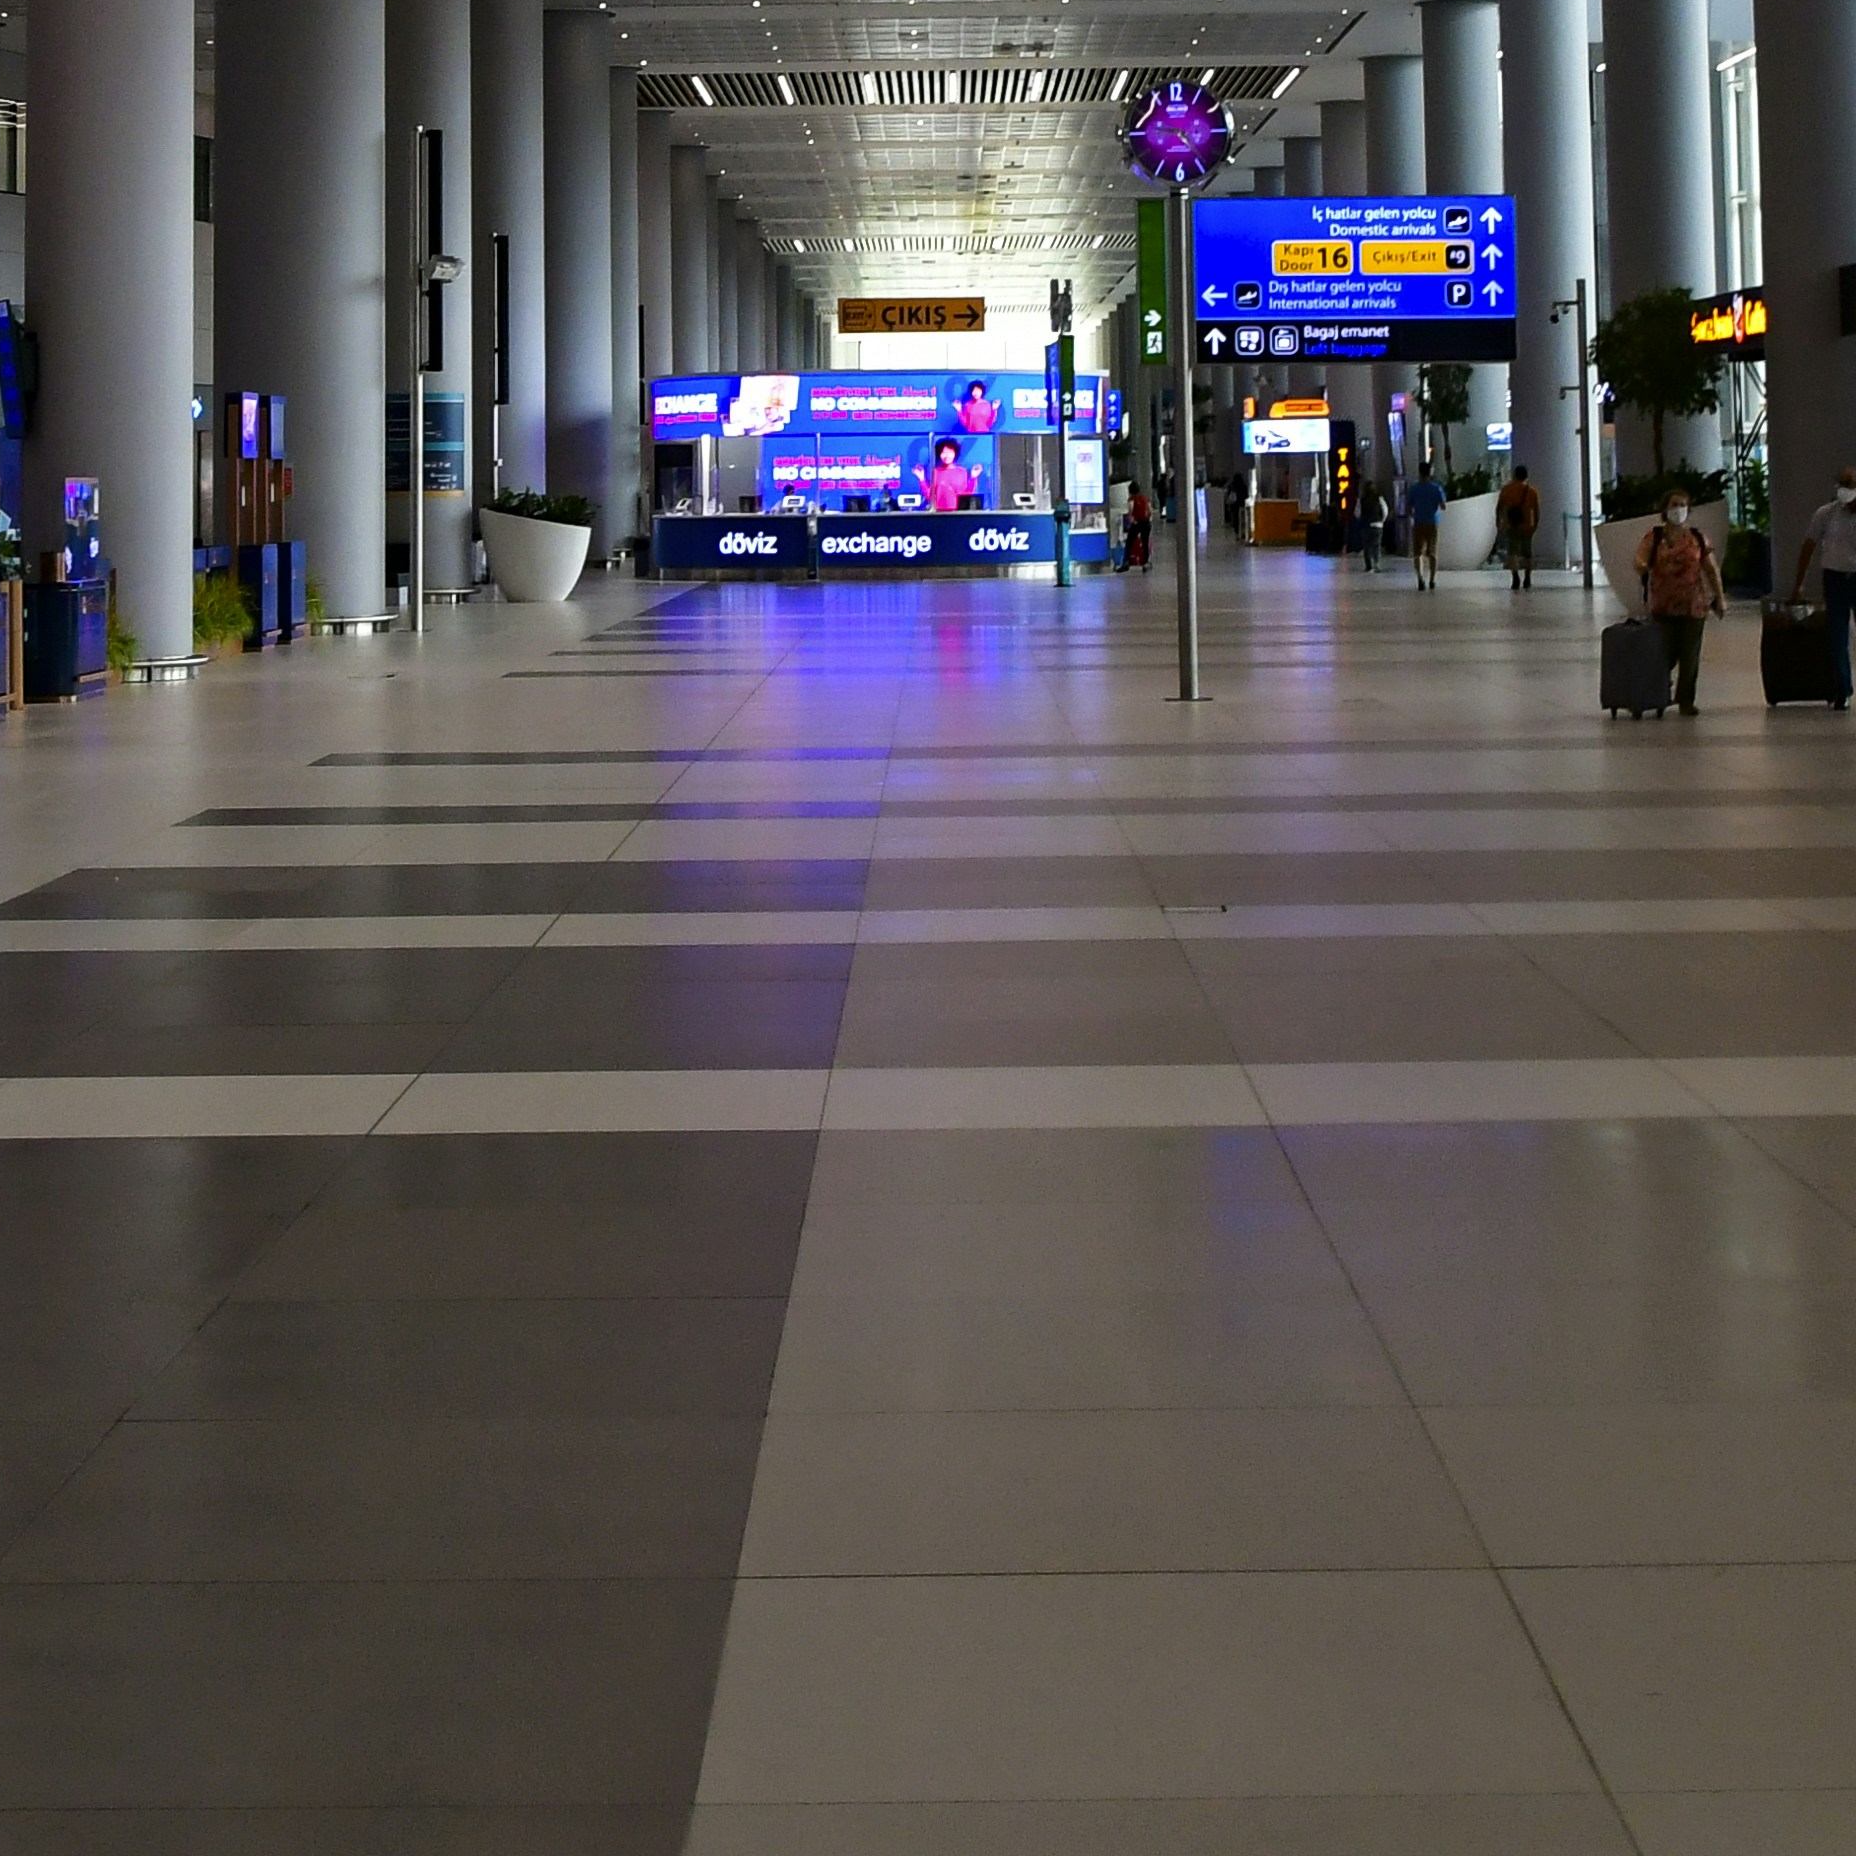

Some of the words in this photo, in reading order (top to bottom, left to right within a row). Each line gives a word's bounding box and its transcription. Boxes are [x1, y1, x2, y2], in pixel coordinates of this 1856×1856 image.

[1170, 83, 1183, 101] 12
[1175, 162, 1185, 182] 6
[1325, 207, 1361, 220] hatlar
[1364, 207, 1400, 223] gelen
[1402, 207, 1437, 222] yolcu
[1329, 224, 1389, 236] Domestic
[1391, 224, 1437, 236] arrivals
[1280, 260, 1314, 271] Door
[1317, 247, 1349, 269] 16
[1269, 281, 1288, 295] Dış
[1291, 280, 1327, 293] hatlar
[1330, 280, 1365, 296] gelen
[1368, 280, 1403, 294] yolcu
[1269, 297, 1349, 310] International
[1352, 297, 1397, 309] arrivals
[881, 305, 947, 331] ÇIKIŞ
[1303, 326, 1338, 341] Bagaj
[1341, 326, 1390, 338] emanet
[719, 532, 778, 555] döviz
[821, 532, 932, 557] exchange
[969, 528, 1029, 551] döviz
